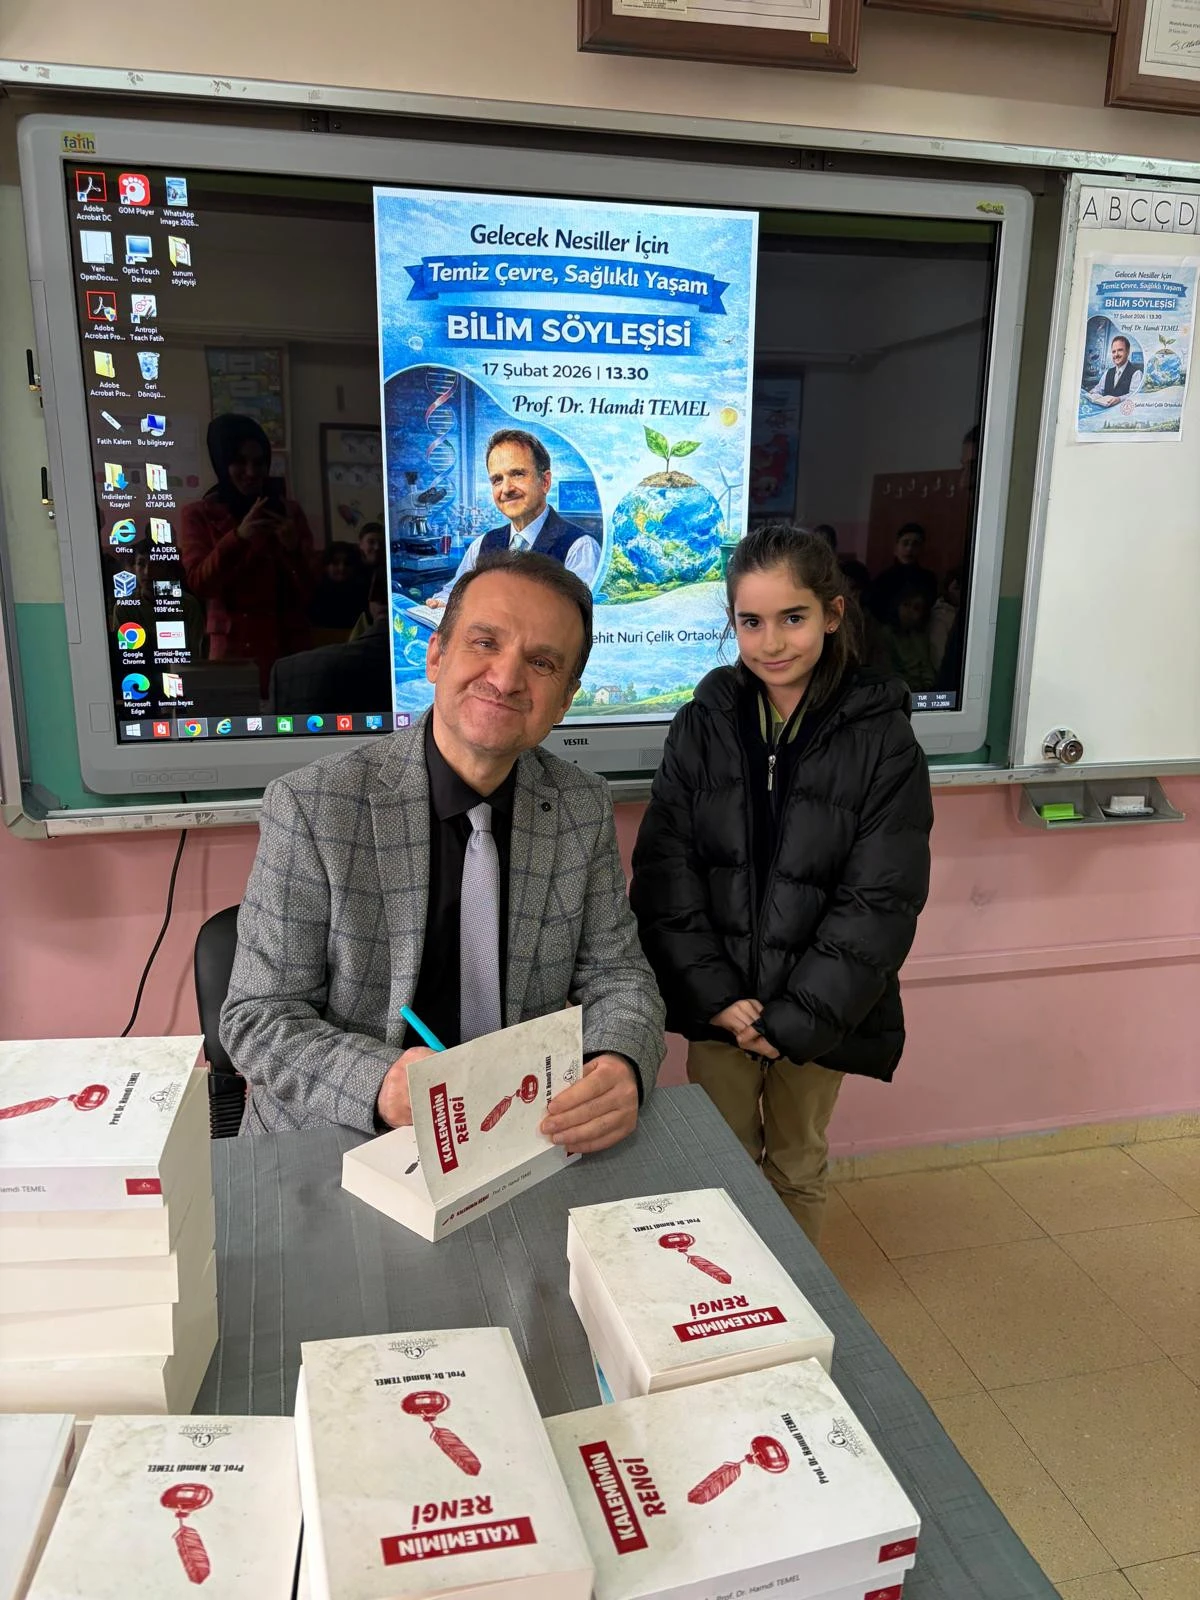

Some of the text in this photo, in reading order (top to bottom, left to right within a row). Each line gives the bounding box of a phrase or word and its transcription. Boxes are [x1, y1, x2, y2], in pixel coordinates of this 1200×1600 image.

[63, 134, 95, 150] fatih
[83, 205, 104, 213] Adobe
[118, 206, 154, 217] GOM Player
[163, 209, 195, 219] WhatsApp
[1082, 196, 1195, 229] A B C Ç D
[77, 213, 112, 222] Acrobat DC
[160, 218, 180, 226] Image
[470, 223, 670, 258] Gelecek Nesiller İçin
[122, 266, 160, 275] Optic Touch
[131, 276, 152, 284] Device
[428, 262, 709, 297] Temiz Çevre, Sağlıklı Yaşam
[1162, 284, 1182, 292] Yaşam
[1105, 298, 1176, 309] BİLİM SÖYLEŞİSİ
[94, 324, 115, 332] Adobe
[135, 326, 158, 335] Antropi
[447, 311, 691, 351] BİLİM SÖYLEŞİSİ
[85, 332, 109, 340] Acrobat
[130, 334, 149, 342] Teach
[482, 363, 499, 377] 17
[503, 364, 549, 380] Şubat
[552, 366, 592, 379] 2026
[606, 367, 649, 381] 13.30
[90, 389, 115, 397] Acrobat
[512, 394, 710, 418] Prof. Dr. Hamdi TEMEL
[147, 439, 174, 447] bilgisayar
[592, 632, 614, 644] ehit
[617, 631, 643, 643] Nuri
[646, 630, 675, 645] Çelik
[563, 738, 589, 746] VESTEL
[126, 1072, 140, 1087] TEMEL
[449, 1096, 470, 1144] RENGİ
[436, 1092, 454, 1162] KALEMİMİN
[689, 1295, 749, 1320] RENGİ
[688, 1310, 774, 1337] KALEMİMİN
[403, 1374, 431, 1383] Hamdi
[445, 1370, 466, 1378] Prof.
[374, 1377, 402, 1386] TEMEL
[781, 1413, 830, 1484] Prof. Dr. Hamdi TEMEL
[148, 1464, 244, 1472] Prof. Dr. Hamdi TEMEL
[618, 1457, 667, 1517] RENGİ
[590, 1451, 638, 1540] KALEMİMİN
[411, 1495, 494, 1530] RENGİ
[398, 1524, 520, 1559] KALEMİMİN
[749, 1582, 774, 1593] Hamdi
[776, 1575, 800, 1586] TEMEL
